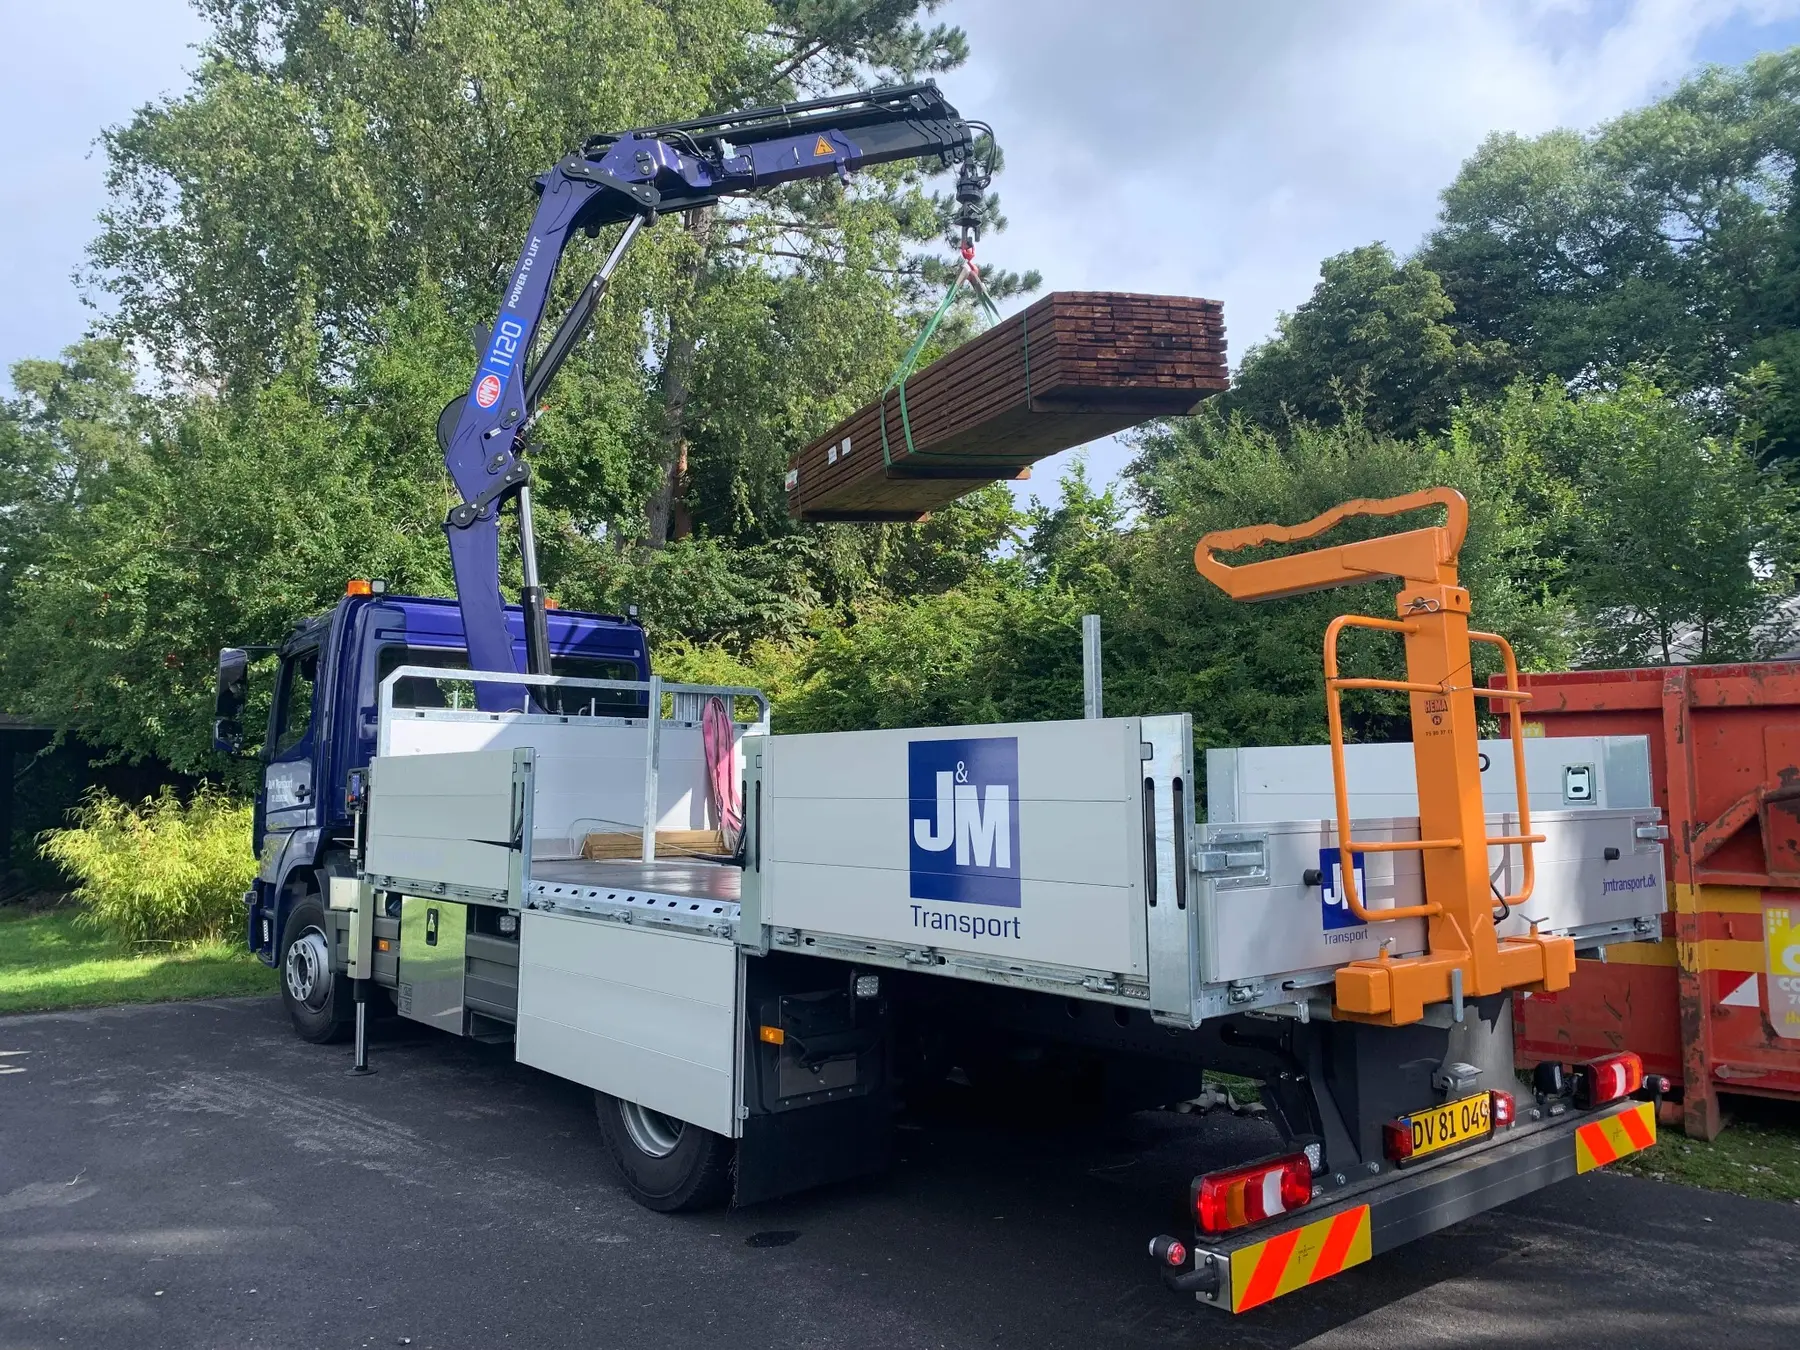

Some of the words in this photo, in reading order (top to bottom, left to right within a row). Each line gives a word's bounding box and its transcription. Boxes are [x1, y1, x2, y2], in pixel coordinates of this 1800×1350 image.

[508, 273, 528, 308] POWER
[521, 258, 533, 272] TO
[527, 236, 541, 257] LIFT
[489, 321, 522, 367] 1120
[478, 379, 499, 404] HMF
[1602, 873, 1657, 896] jmtransport.dk
[910, 905, 1021, 939] Transport
[1323, 928, 1368, 945] Transport
[1412, 1115, 1435, 1150] DV
[1439, 1110, 1456, 1141] 81
[1462, 1099, 1489, 1133] 049
